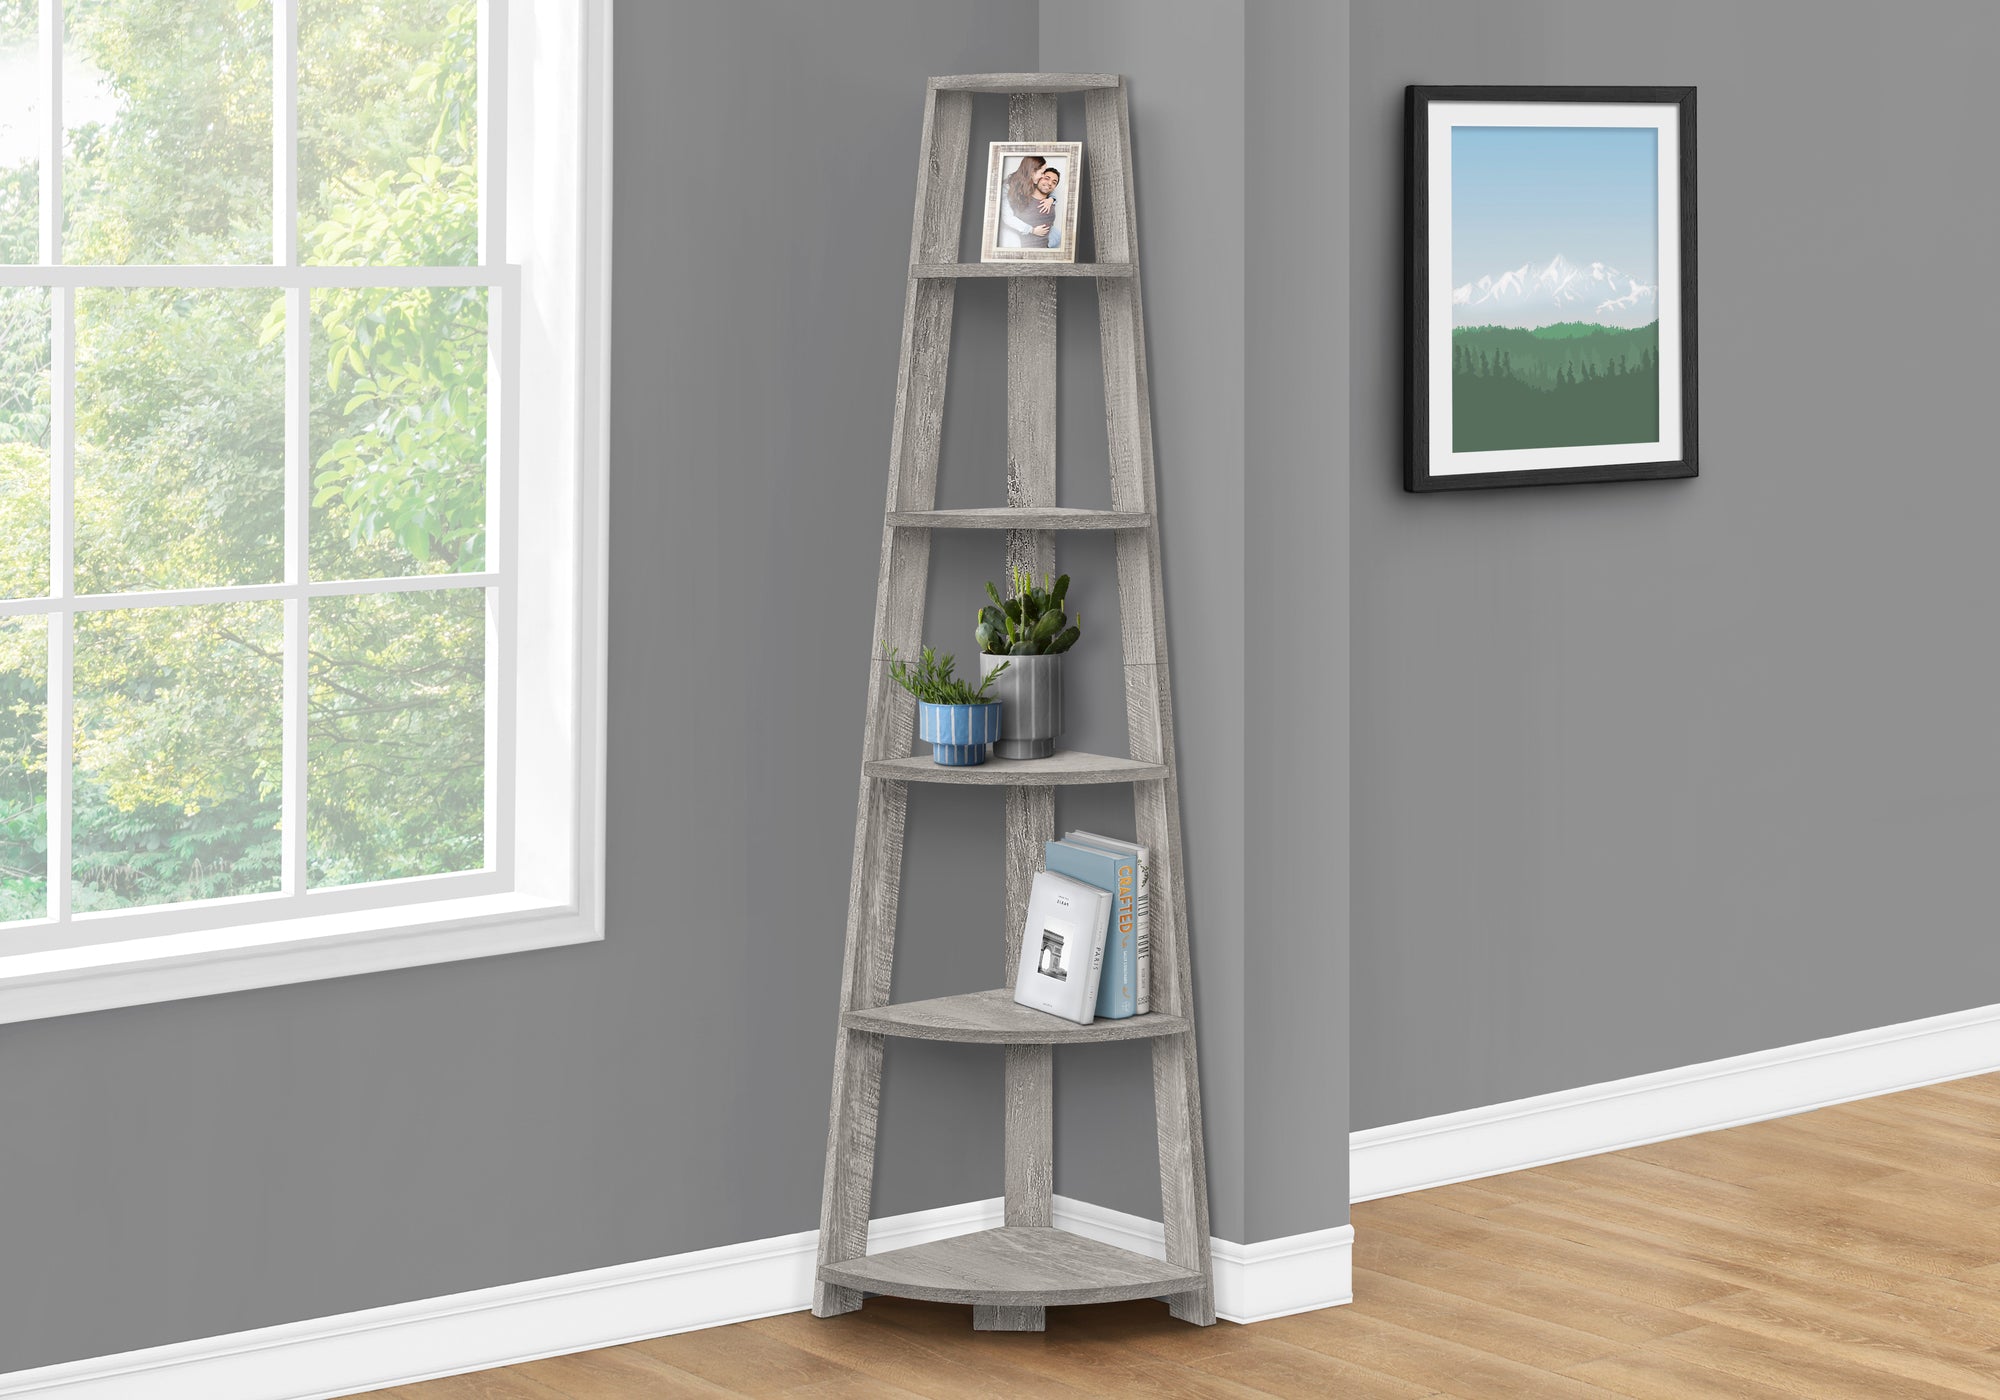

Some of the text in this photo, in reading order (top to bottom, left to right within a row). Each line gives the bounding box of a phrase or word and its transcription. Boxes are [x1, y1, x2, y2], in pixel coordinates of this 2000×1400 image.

[1119, 865, 1133, 933] CRAFTED
[1138, 893, 1149, 917] WILD
[1092, 946, 1102, 971] PARIS
[1138, 933, 1149, 960] HOME
